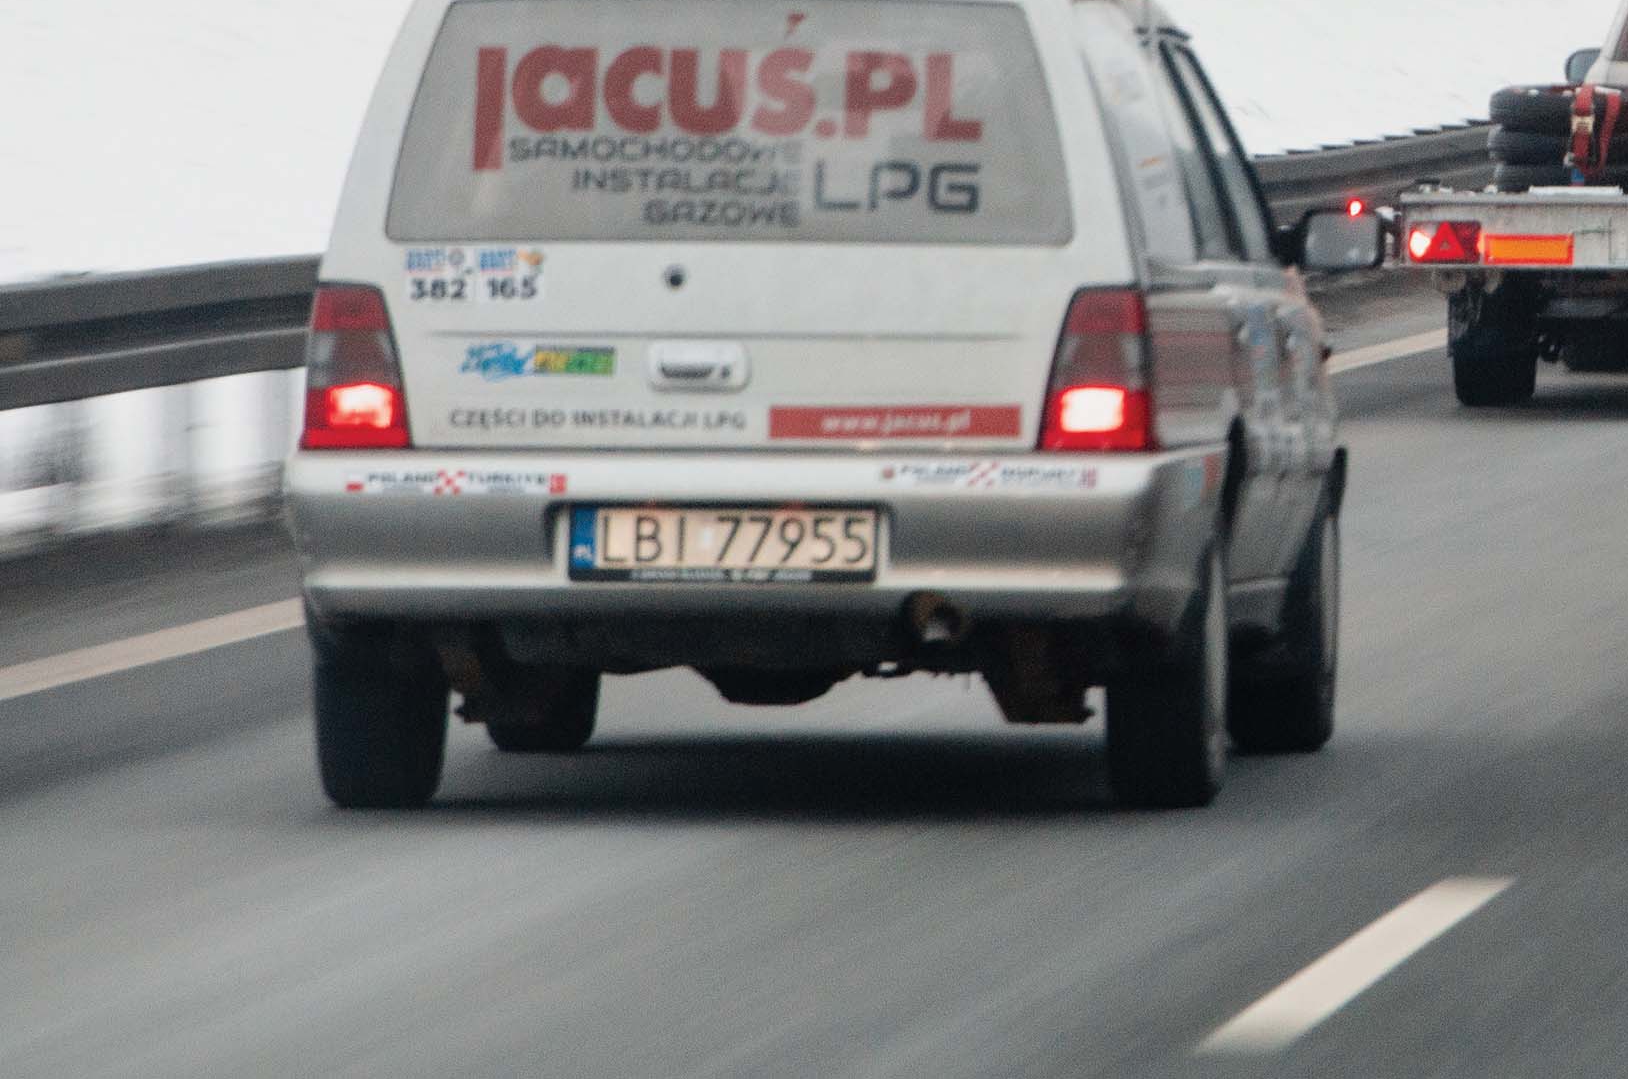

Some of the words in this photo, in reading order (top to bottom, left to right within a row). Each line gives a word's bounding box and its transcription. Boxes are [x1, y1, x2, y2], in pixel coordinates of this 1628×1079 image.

[812, 159, 982, 216] LPG
[638, 198, 803, 228] GAZOWE
[410, 277, 468, 301] 382
[486, 275, 539, 301] 165
[532, 408, 567, 428] DO
[703, 408, 747, 430] LPG
[603, 515, 686, 563] LBI
[716, 515, 868, 563] 77955
